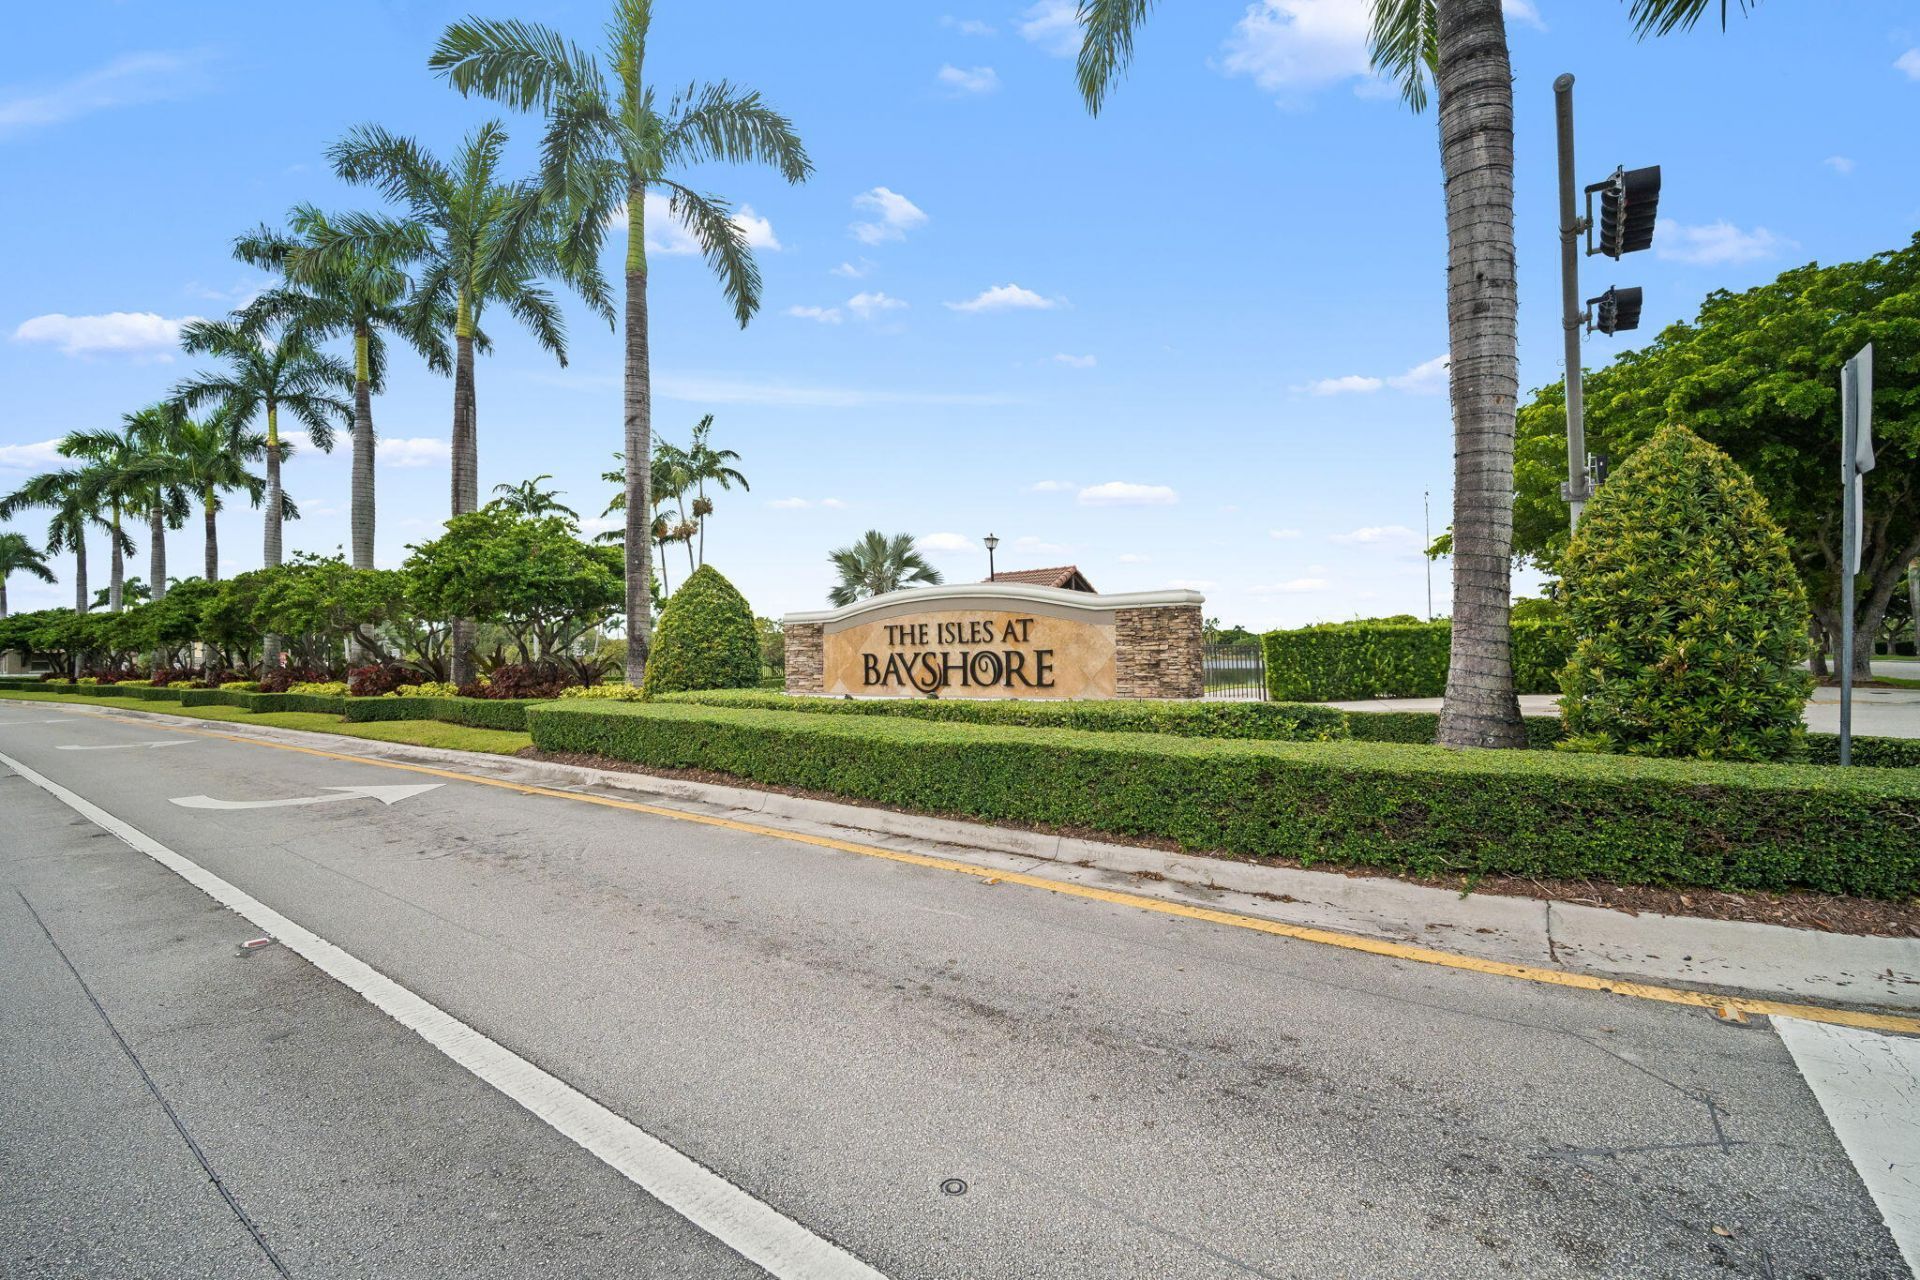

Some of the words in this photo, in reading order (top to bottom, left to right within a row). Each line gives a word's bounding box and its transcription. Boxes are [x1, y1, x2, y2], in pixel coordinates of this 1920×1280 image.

[884, 623, 929, 646] THE
[938, 620, 994, 645] ISLES
[1003, 618, 1034, 643] AT
[863, 649, 1055, 693] BAYSHORE
